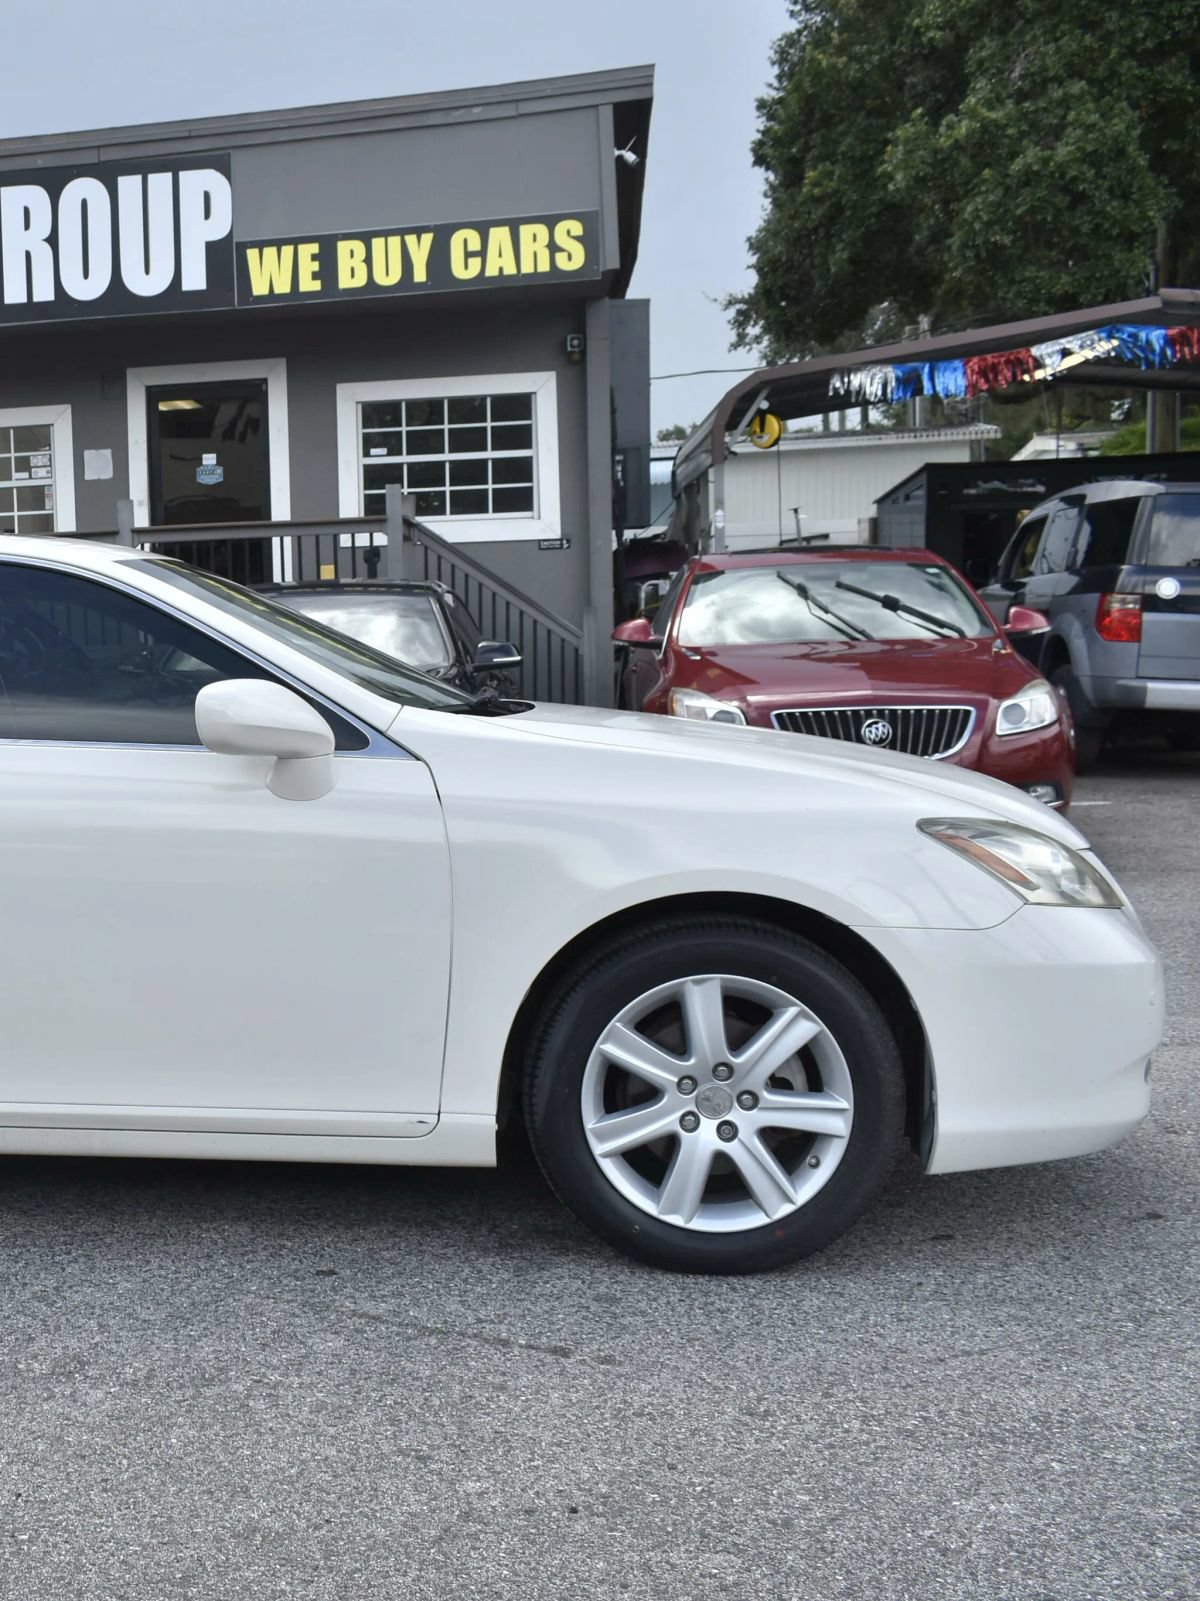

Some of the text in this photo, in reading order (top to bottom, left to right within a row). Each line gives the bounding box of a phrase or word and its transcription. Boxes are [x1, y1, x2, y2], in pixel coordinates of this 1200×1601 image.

[246, 219, 586, 296] WE BUY CARS
